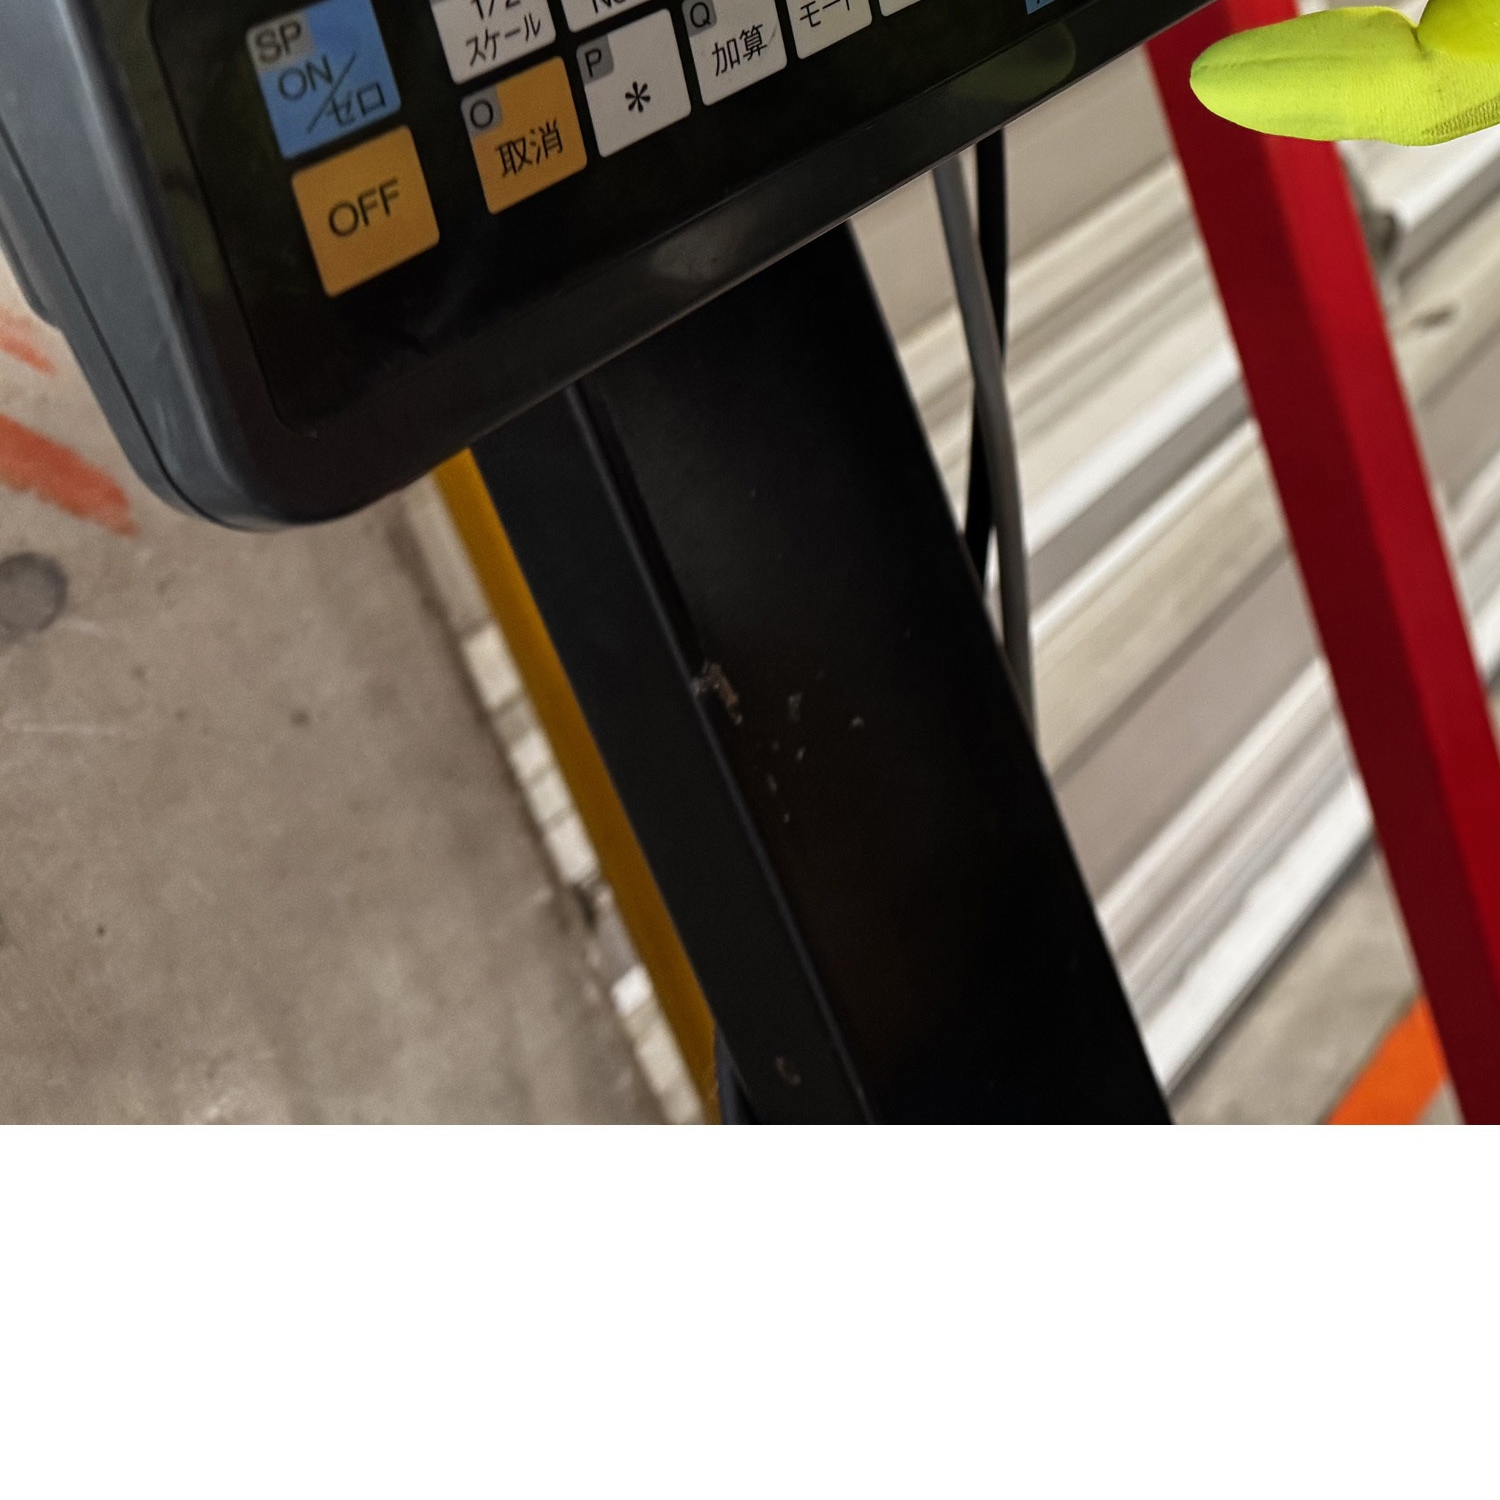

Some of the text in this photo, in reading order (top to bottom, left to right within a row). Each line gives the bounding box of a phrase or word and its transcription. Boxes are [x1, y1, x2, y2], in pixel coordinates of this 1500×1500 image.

[465, 12, 542, 68] スケール
[688, 0, 713, 29] Q
[255, 20, 302, 64] SP
[584, 47, 605, 79] P
[711, 23, 769, 76] 加算
[495, 118, 565, 178] 取消
[328, 177, 400, 237] OFF
